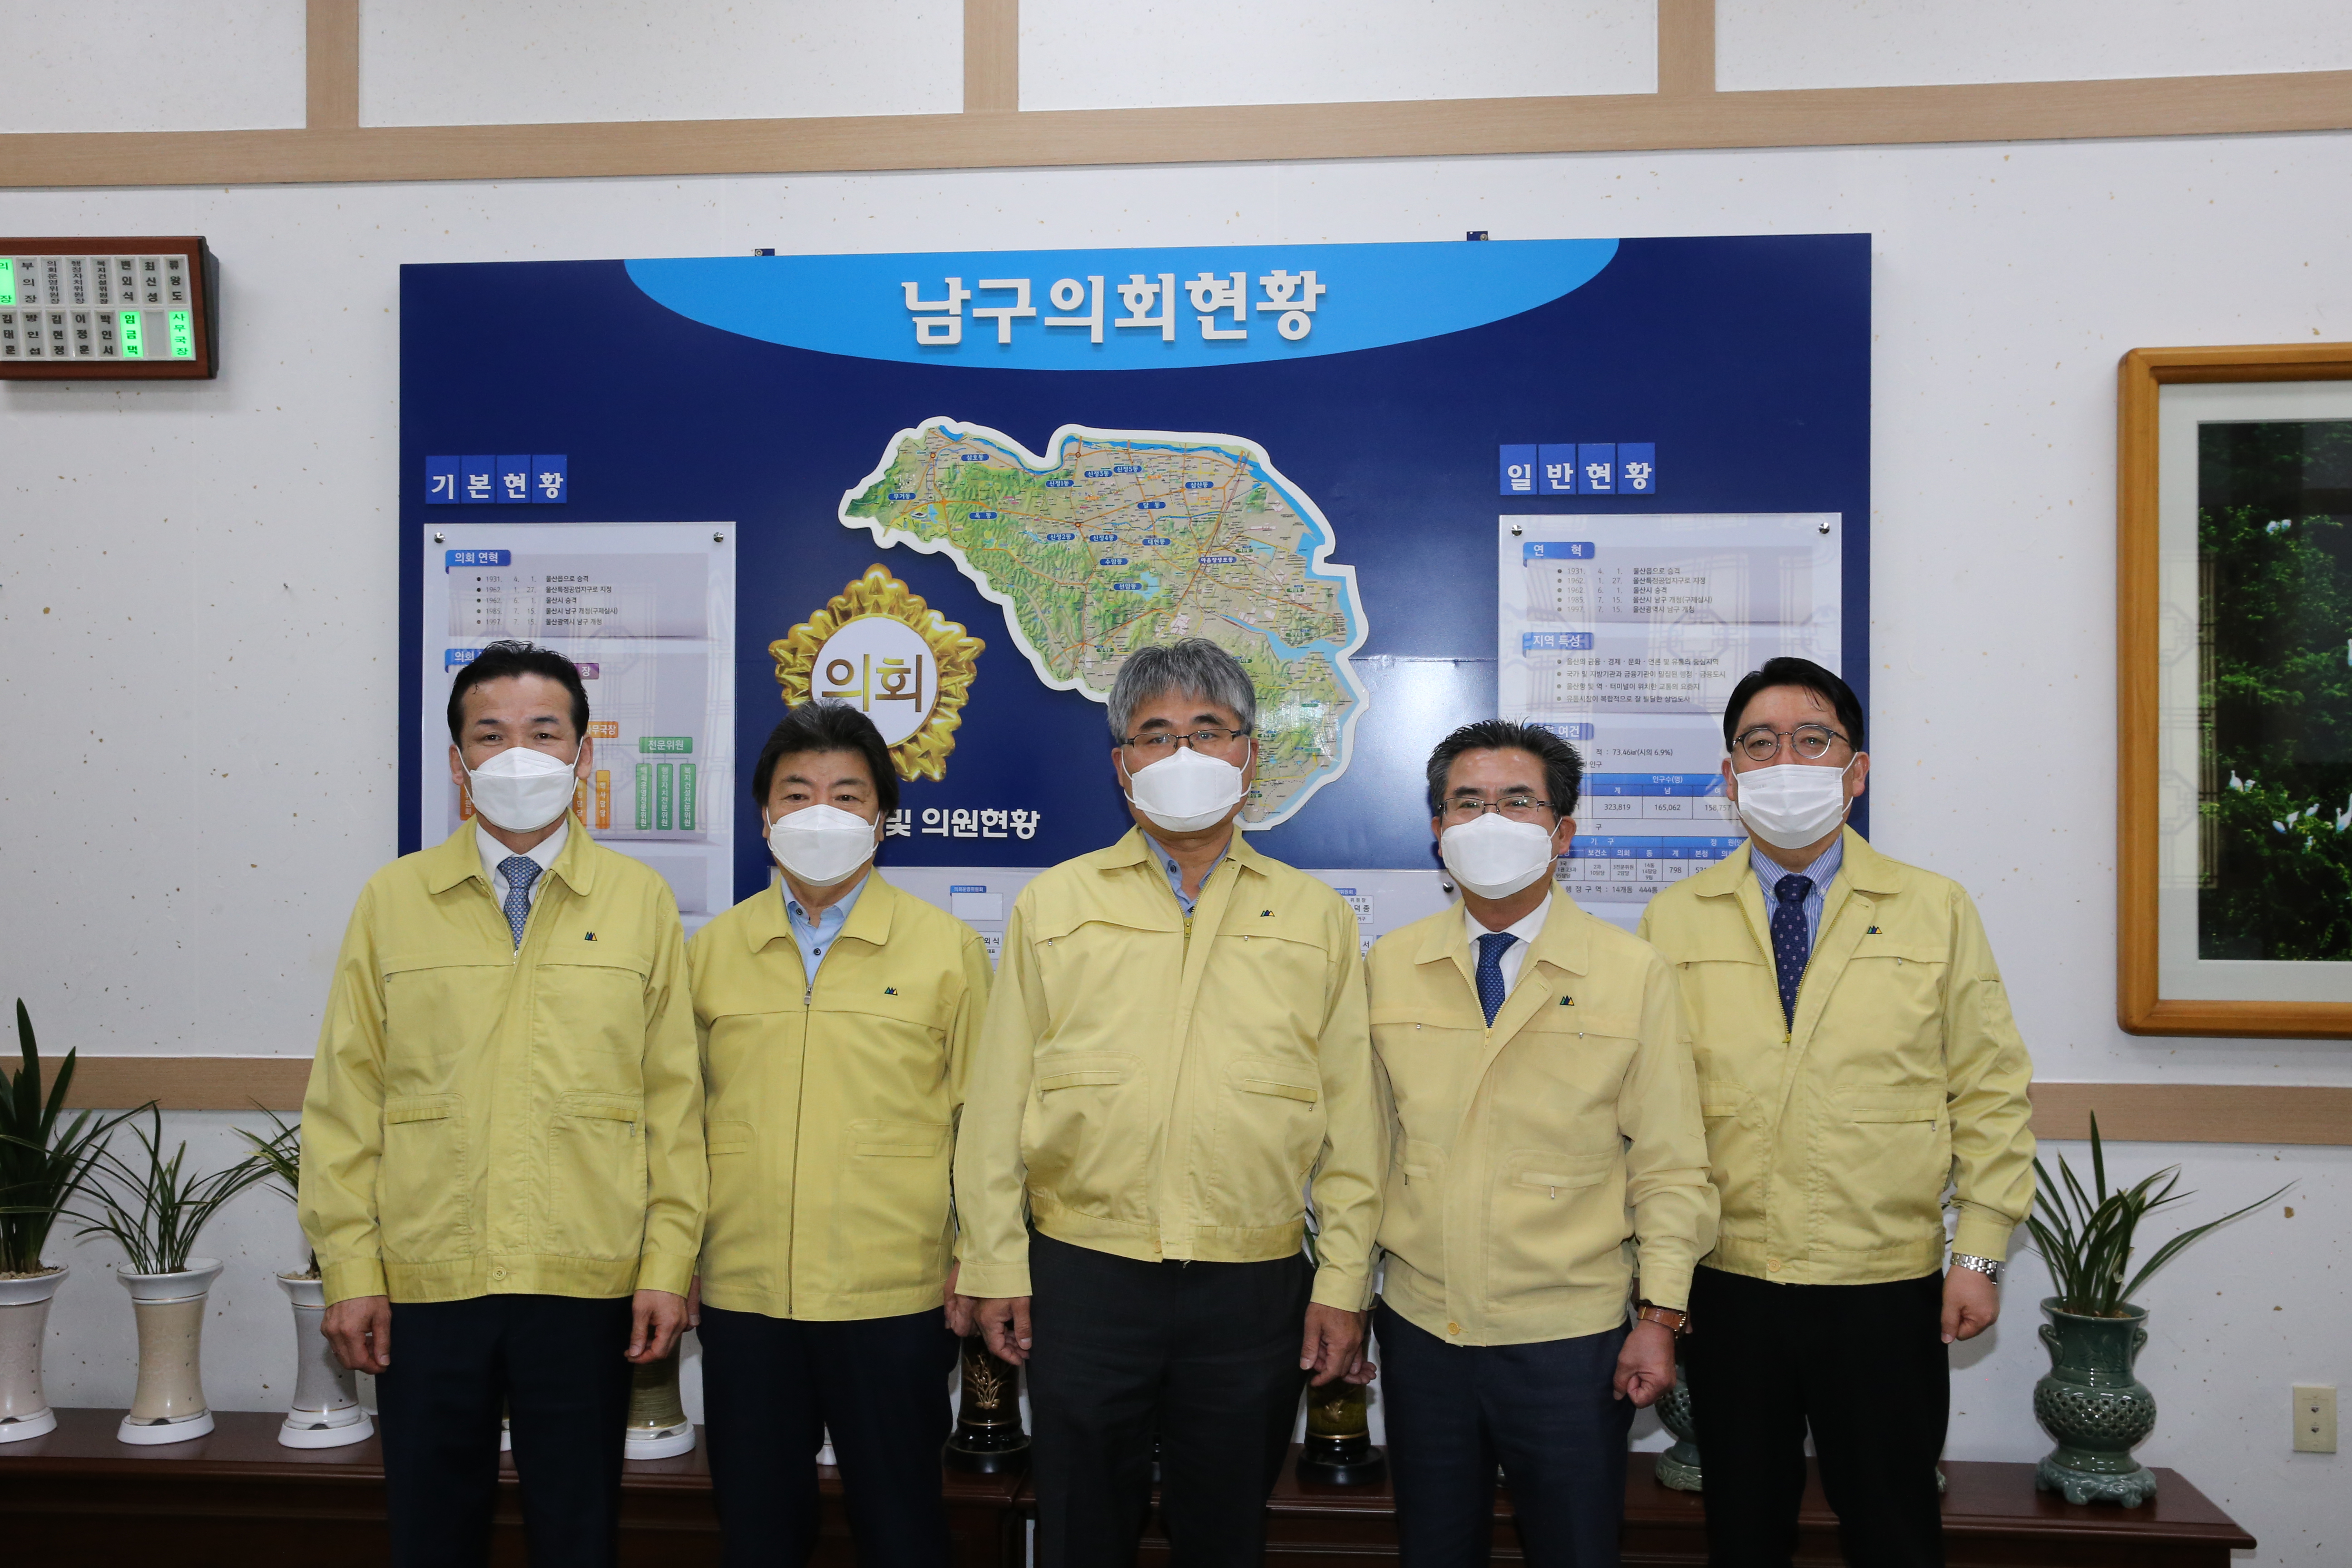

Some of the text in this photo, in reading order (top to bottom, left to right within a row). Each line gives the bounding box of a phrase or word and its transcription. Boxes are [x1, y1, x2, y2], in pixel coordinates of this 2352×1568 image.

[0, 262, 12, 304] 의장
[21, 262, 37, 303] 부의장
[47, 261, 59, 304] 의회운영위원장
[71, 261, 85, 304] 행정자치위원장
[97, 261, 108, 304] 복지건설위원장
[145, 262, 157, 302] 최신성
[901, 270, 1326, 346] 남구의회현황
[2, 314, 15, 354] 김태훈
[26, 314, 40, 355] 방인섭
[52, 315, 64, 355] 김현정
[76, 314, 89, 354] 이정훈
[100, 315, 113, 355] 박인서
[125, 315, 138, 355] 임금택
[173, 314, 188, 355] 사무국장
[431, 472, 564, 500] 기본현황
[1508, 461, 1651, 491] 일반현황
[455, 552, 498, 564] 의회 연혁
[455, 651, 474, 662] 의회
[1534, 635, 1580, 647] 지역 특성
[822, 654, 922, 712] 의회
[649, 740, 684, 750] 전문위원
[1558, 726, 1579, 737] 여건
[922, 808, 1040, 839] 의원현황
